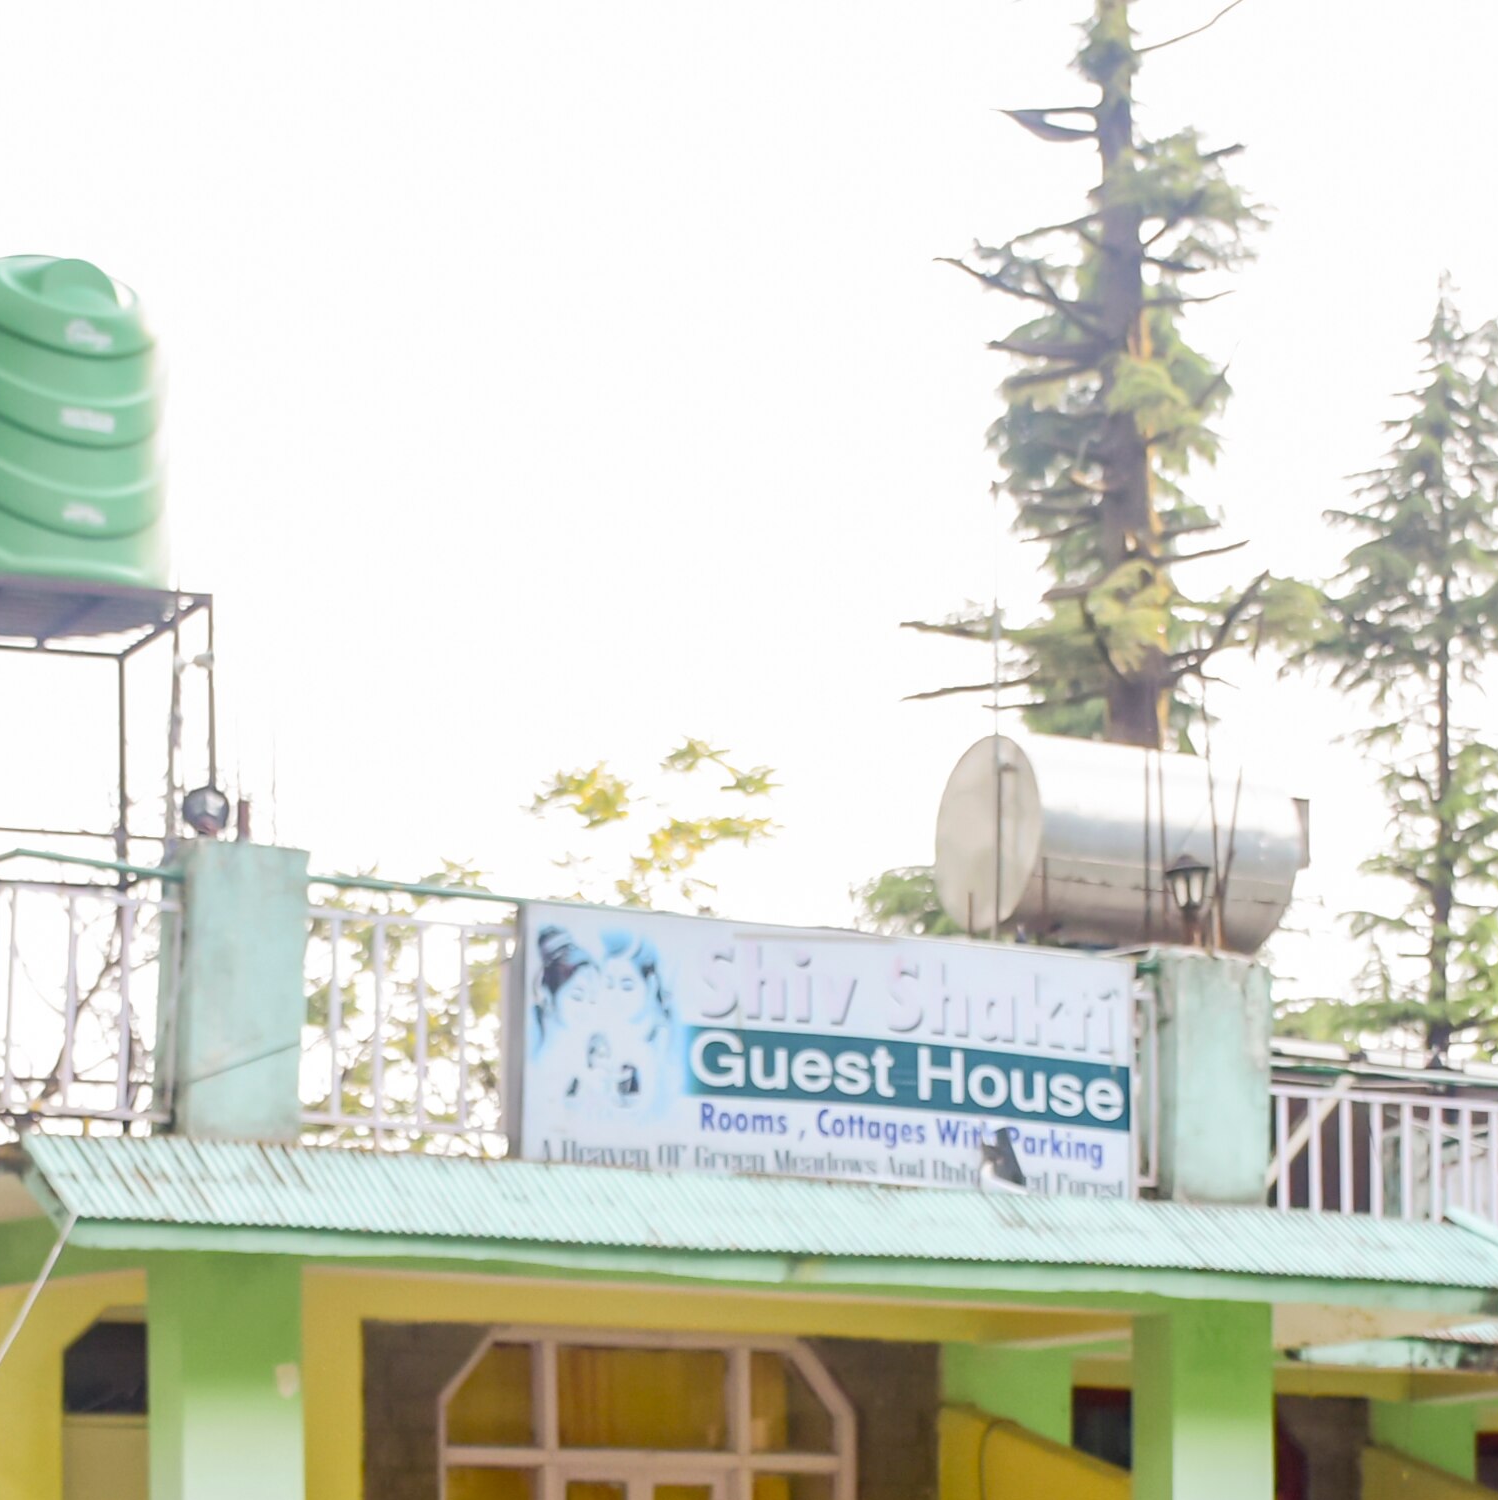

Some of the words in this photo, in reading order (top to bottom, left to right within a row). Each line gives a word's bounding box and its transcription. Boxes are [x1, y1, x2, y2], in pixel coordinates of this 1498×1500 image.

[700, 940, 857, 1027] Shiv
[887, 958, 1118, 1056] Shakti
[689, 1029, 896, 1098] Guest
[917, 1045, 1125, 1122] House
[562, 1139, 651, 1169] Heaven
[694, 1145, 766, 1173] Green
[773, 1150, 878, 1177] Meadows
[888, 1156, 926, 1179] And
[1057, 1172, 1124, 1199] Forest
[700, 1102, 788, 1135] Rooms
[817, 1108, 926, 1148] Cottages
[1004, 1126, 1105, 1168] Parking
